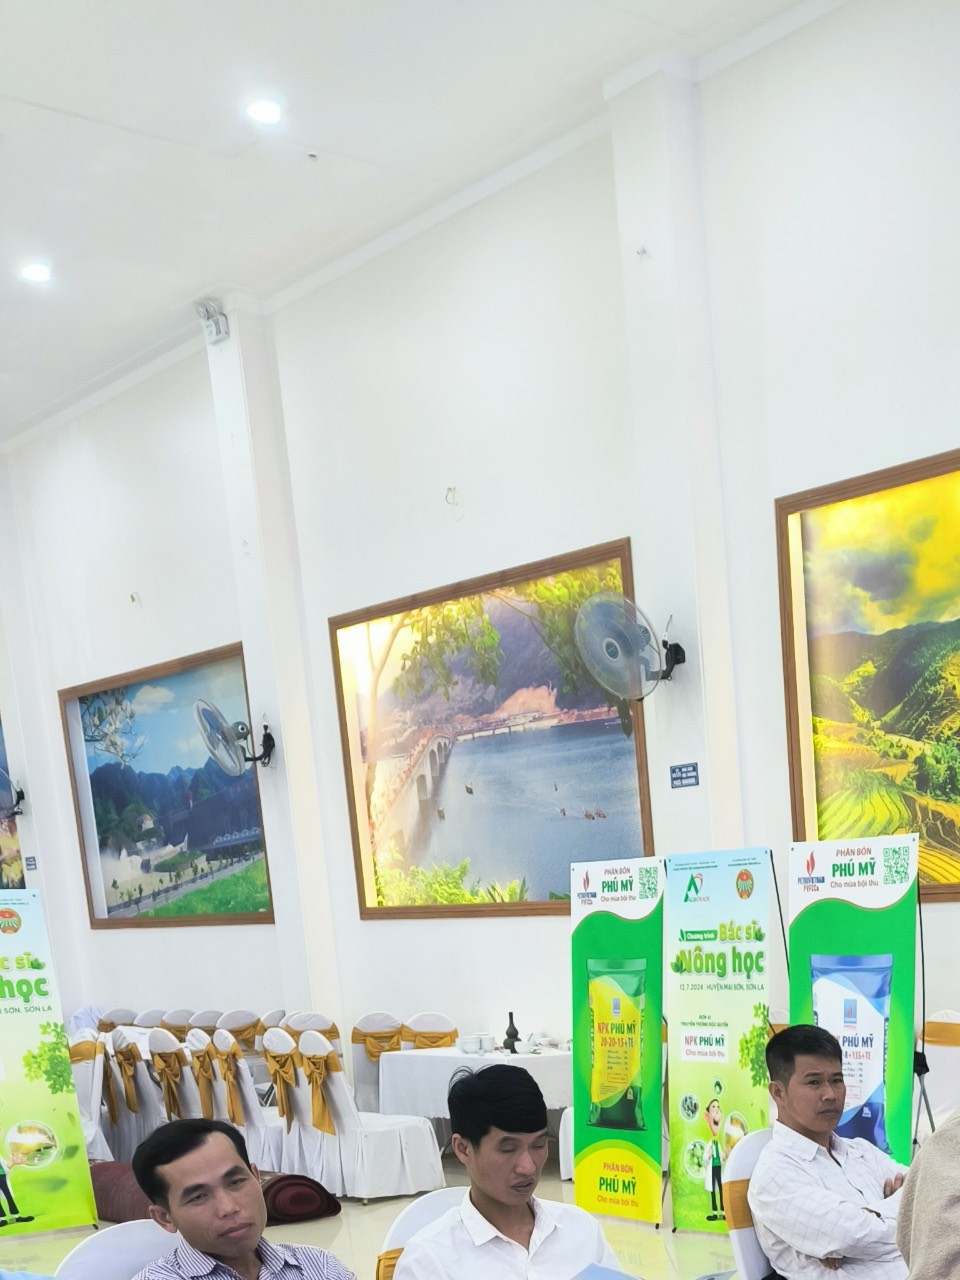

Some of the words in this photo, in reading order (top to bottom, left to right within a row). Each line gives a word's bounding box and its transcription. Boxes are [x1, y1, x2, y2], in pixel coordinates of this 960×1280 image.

[836, 849, 855, 857] PHÂN
[832, 858, 855, 877] PHÚ
[858, 857, 876, 876] MỸ
[602, 877, 618, 893] PHÚ
[621, 876, 633, 891] MỸ
[719, 920, 742, 941] Bác
[745, 920, 758, 940] sĩ
[679, 945, 727, 977] Nông
[732, 945, 764, 979] học
[0, 975, 49, 1003] học
[598, 1022, 609, 1034] NPK
[610, 1020, 624, 1034] PHÚ
[627, 1020, 636, 1035] MỸ
[685, 1036, 697, 1046] NPK
[699, 1034, 713, 1046] PHÚ
[715, 1034, 725, 1046] MỸ
[842, 1033, 859, 1048] PHÚ
[861, 1033, 874, 1048] MỸ
[599, 1174, 619, 1193] PHÚ
[622, 1176, 636, 1195] MỸ
